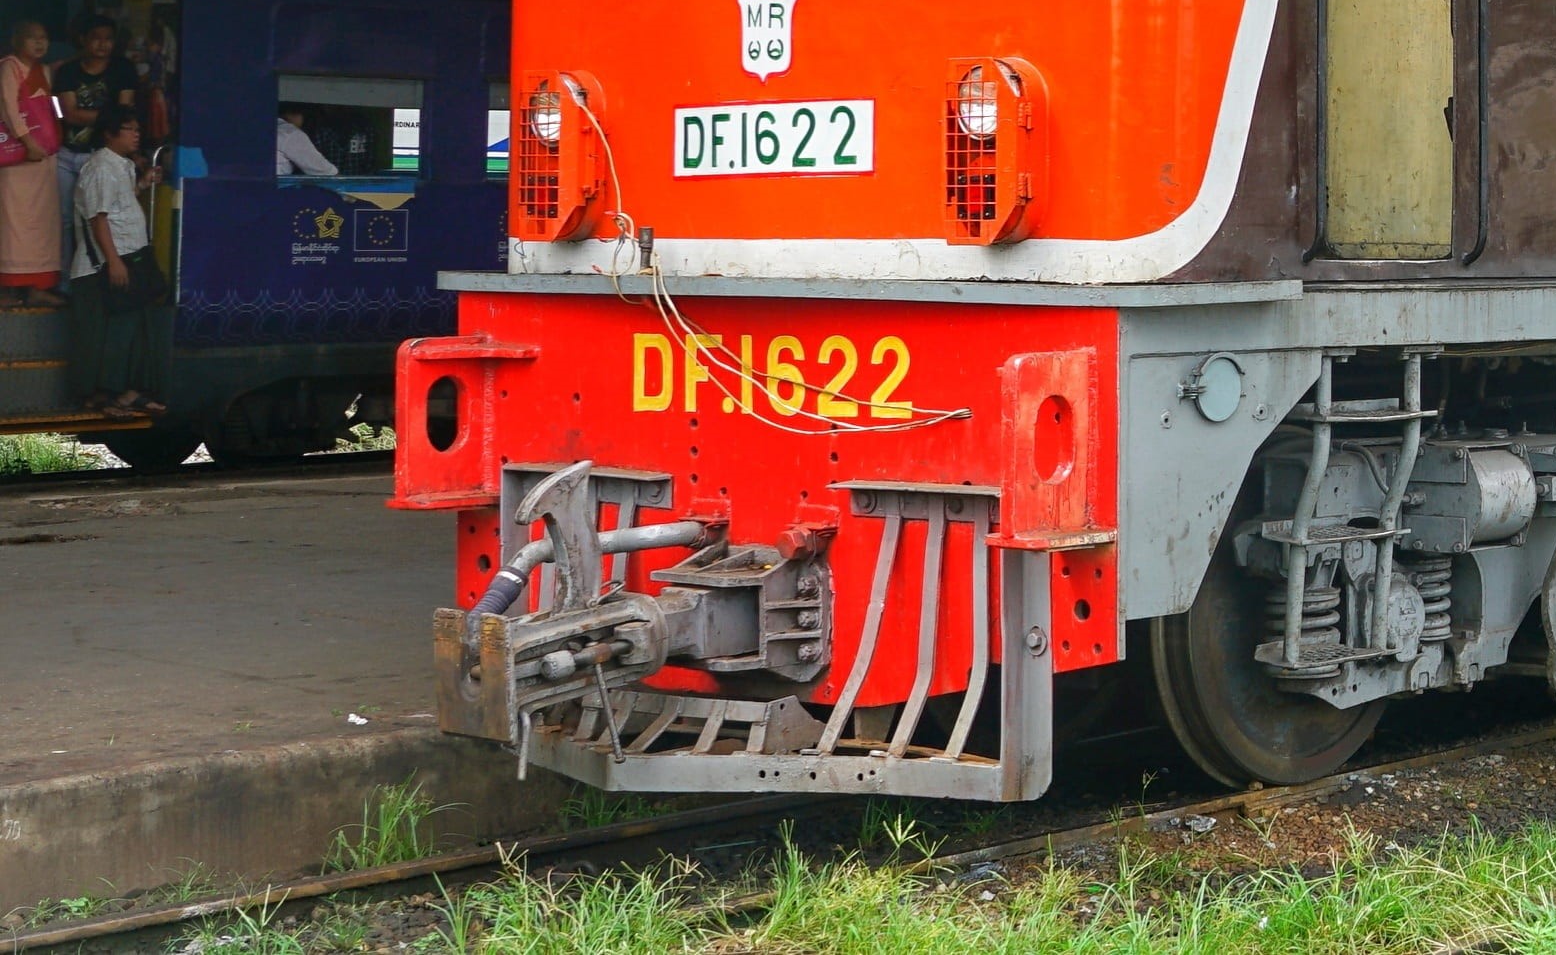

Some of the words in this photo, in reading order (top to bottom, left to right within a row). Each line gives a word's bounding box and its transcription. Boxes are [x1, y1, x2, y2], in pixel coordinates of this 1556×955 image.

[748, 3, 784, 28] MR
[683, 105, 857, 169] DF.1622
[633, 332, 913, 419] DF.1622
